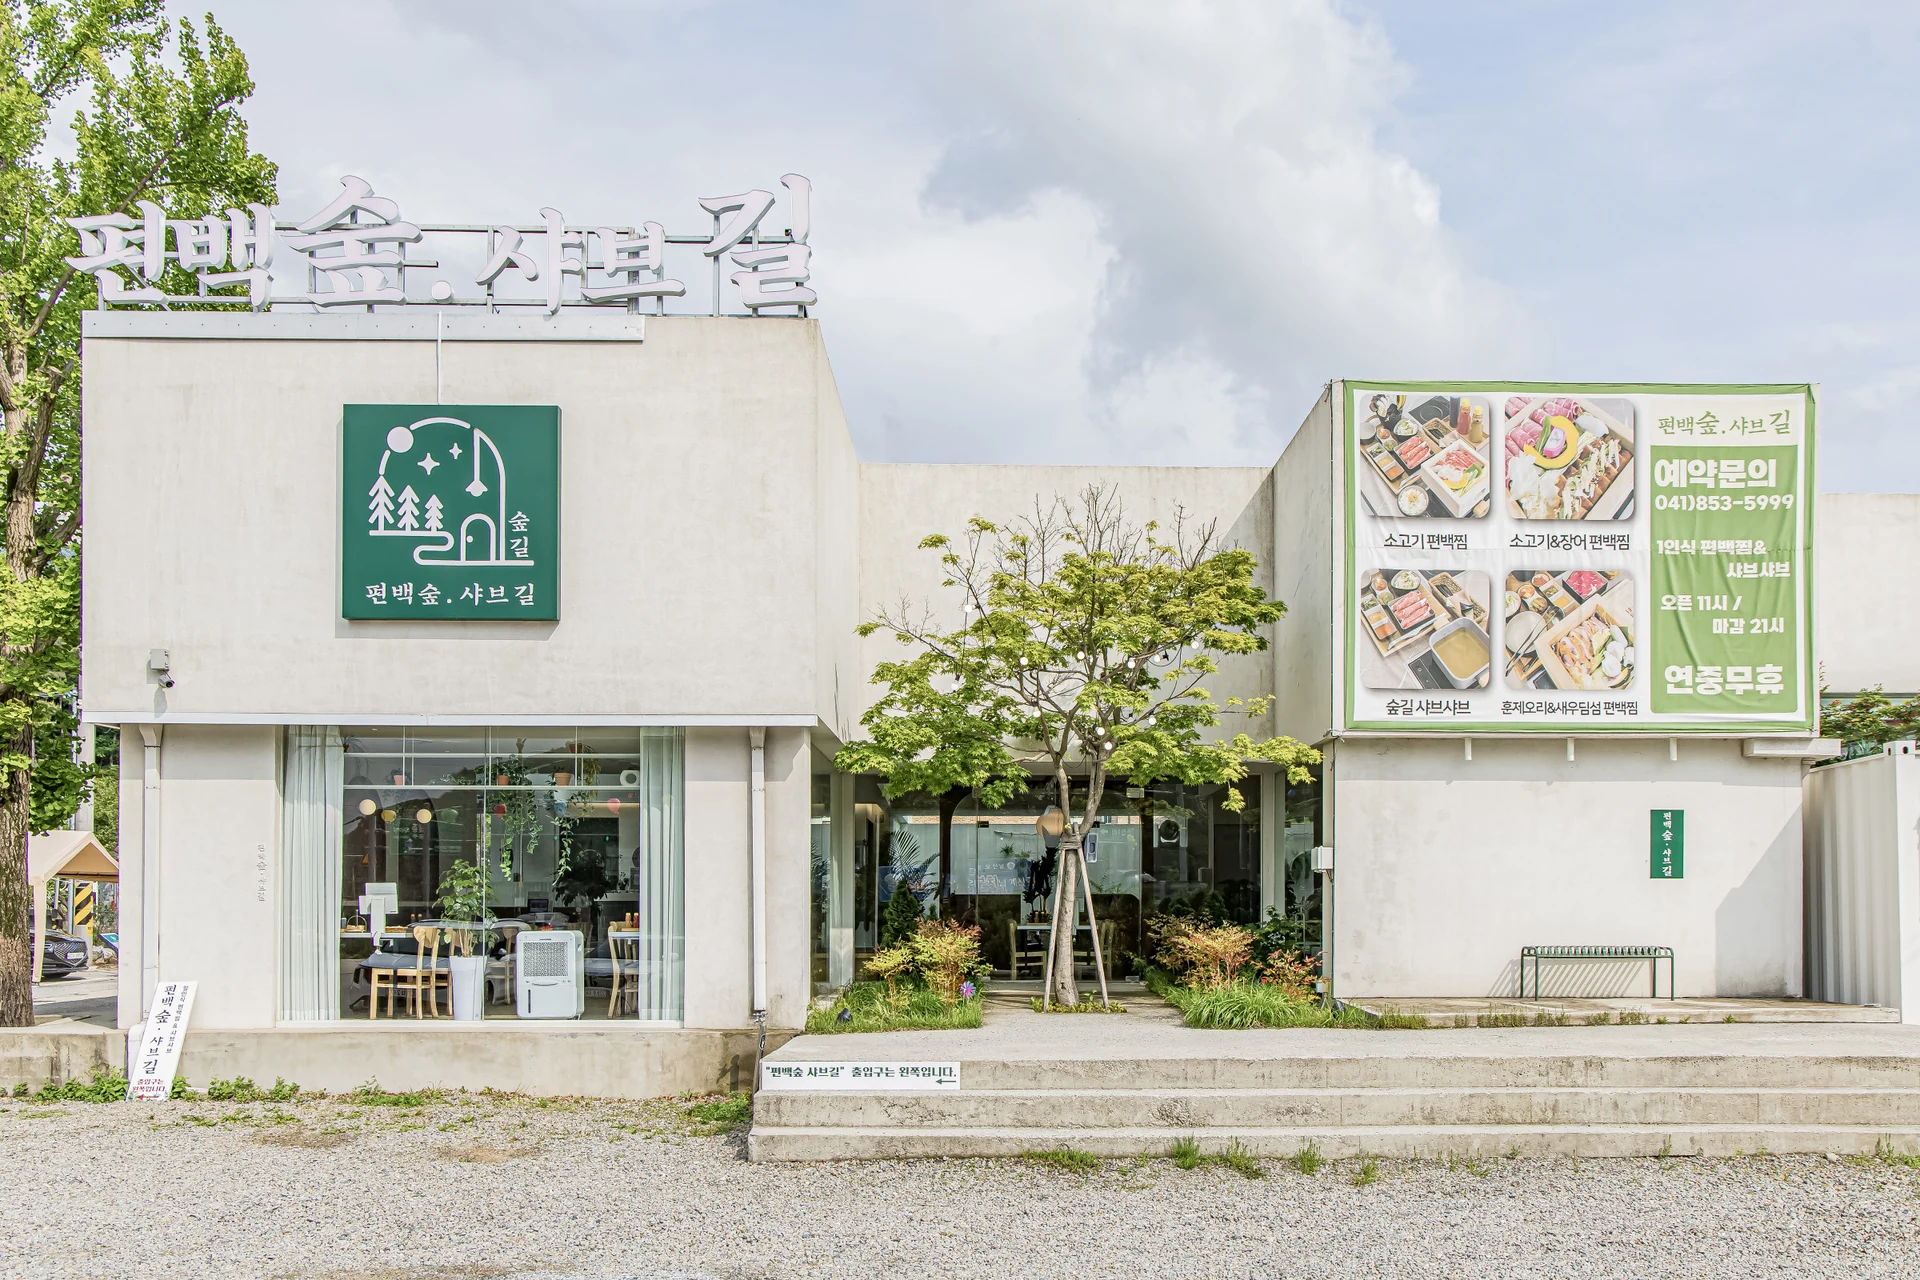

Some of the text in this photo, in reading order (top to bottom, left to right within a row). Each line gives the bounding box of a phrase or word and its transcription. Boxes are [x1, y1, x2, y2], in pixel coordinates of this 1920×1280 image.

[1654, 458, 1777, 489] 예약문의
[1654, 494, 1795, 511] 041)853-5999
[1384, 533, 1468, 550] 소고기 편백찜
[1510, 533, 1630, 551] 소고기&장어 편백찜
[1656, 539, 1767, 555] 1인식 편백찜&
[1726, 561, 1791, 578] 샤브샤브
[1660, 594, 1693, 611] 오픈
[1697, 594, 1728, 611] 11시
[1712, 617, 1785, 635] 마감 21시
[1664, 663, 1784, 696] 연중무휴
[1385, 698, 1471, 716] 숲길 샤브샤브
[1501, 700, 1638, 716] 훈제오리&새우딤섬 편백찜
[851, 1066, 895, 1078] 출입구는
[898, 1066, 957, 1078] 왼쪽입니다.
